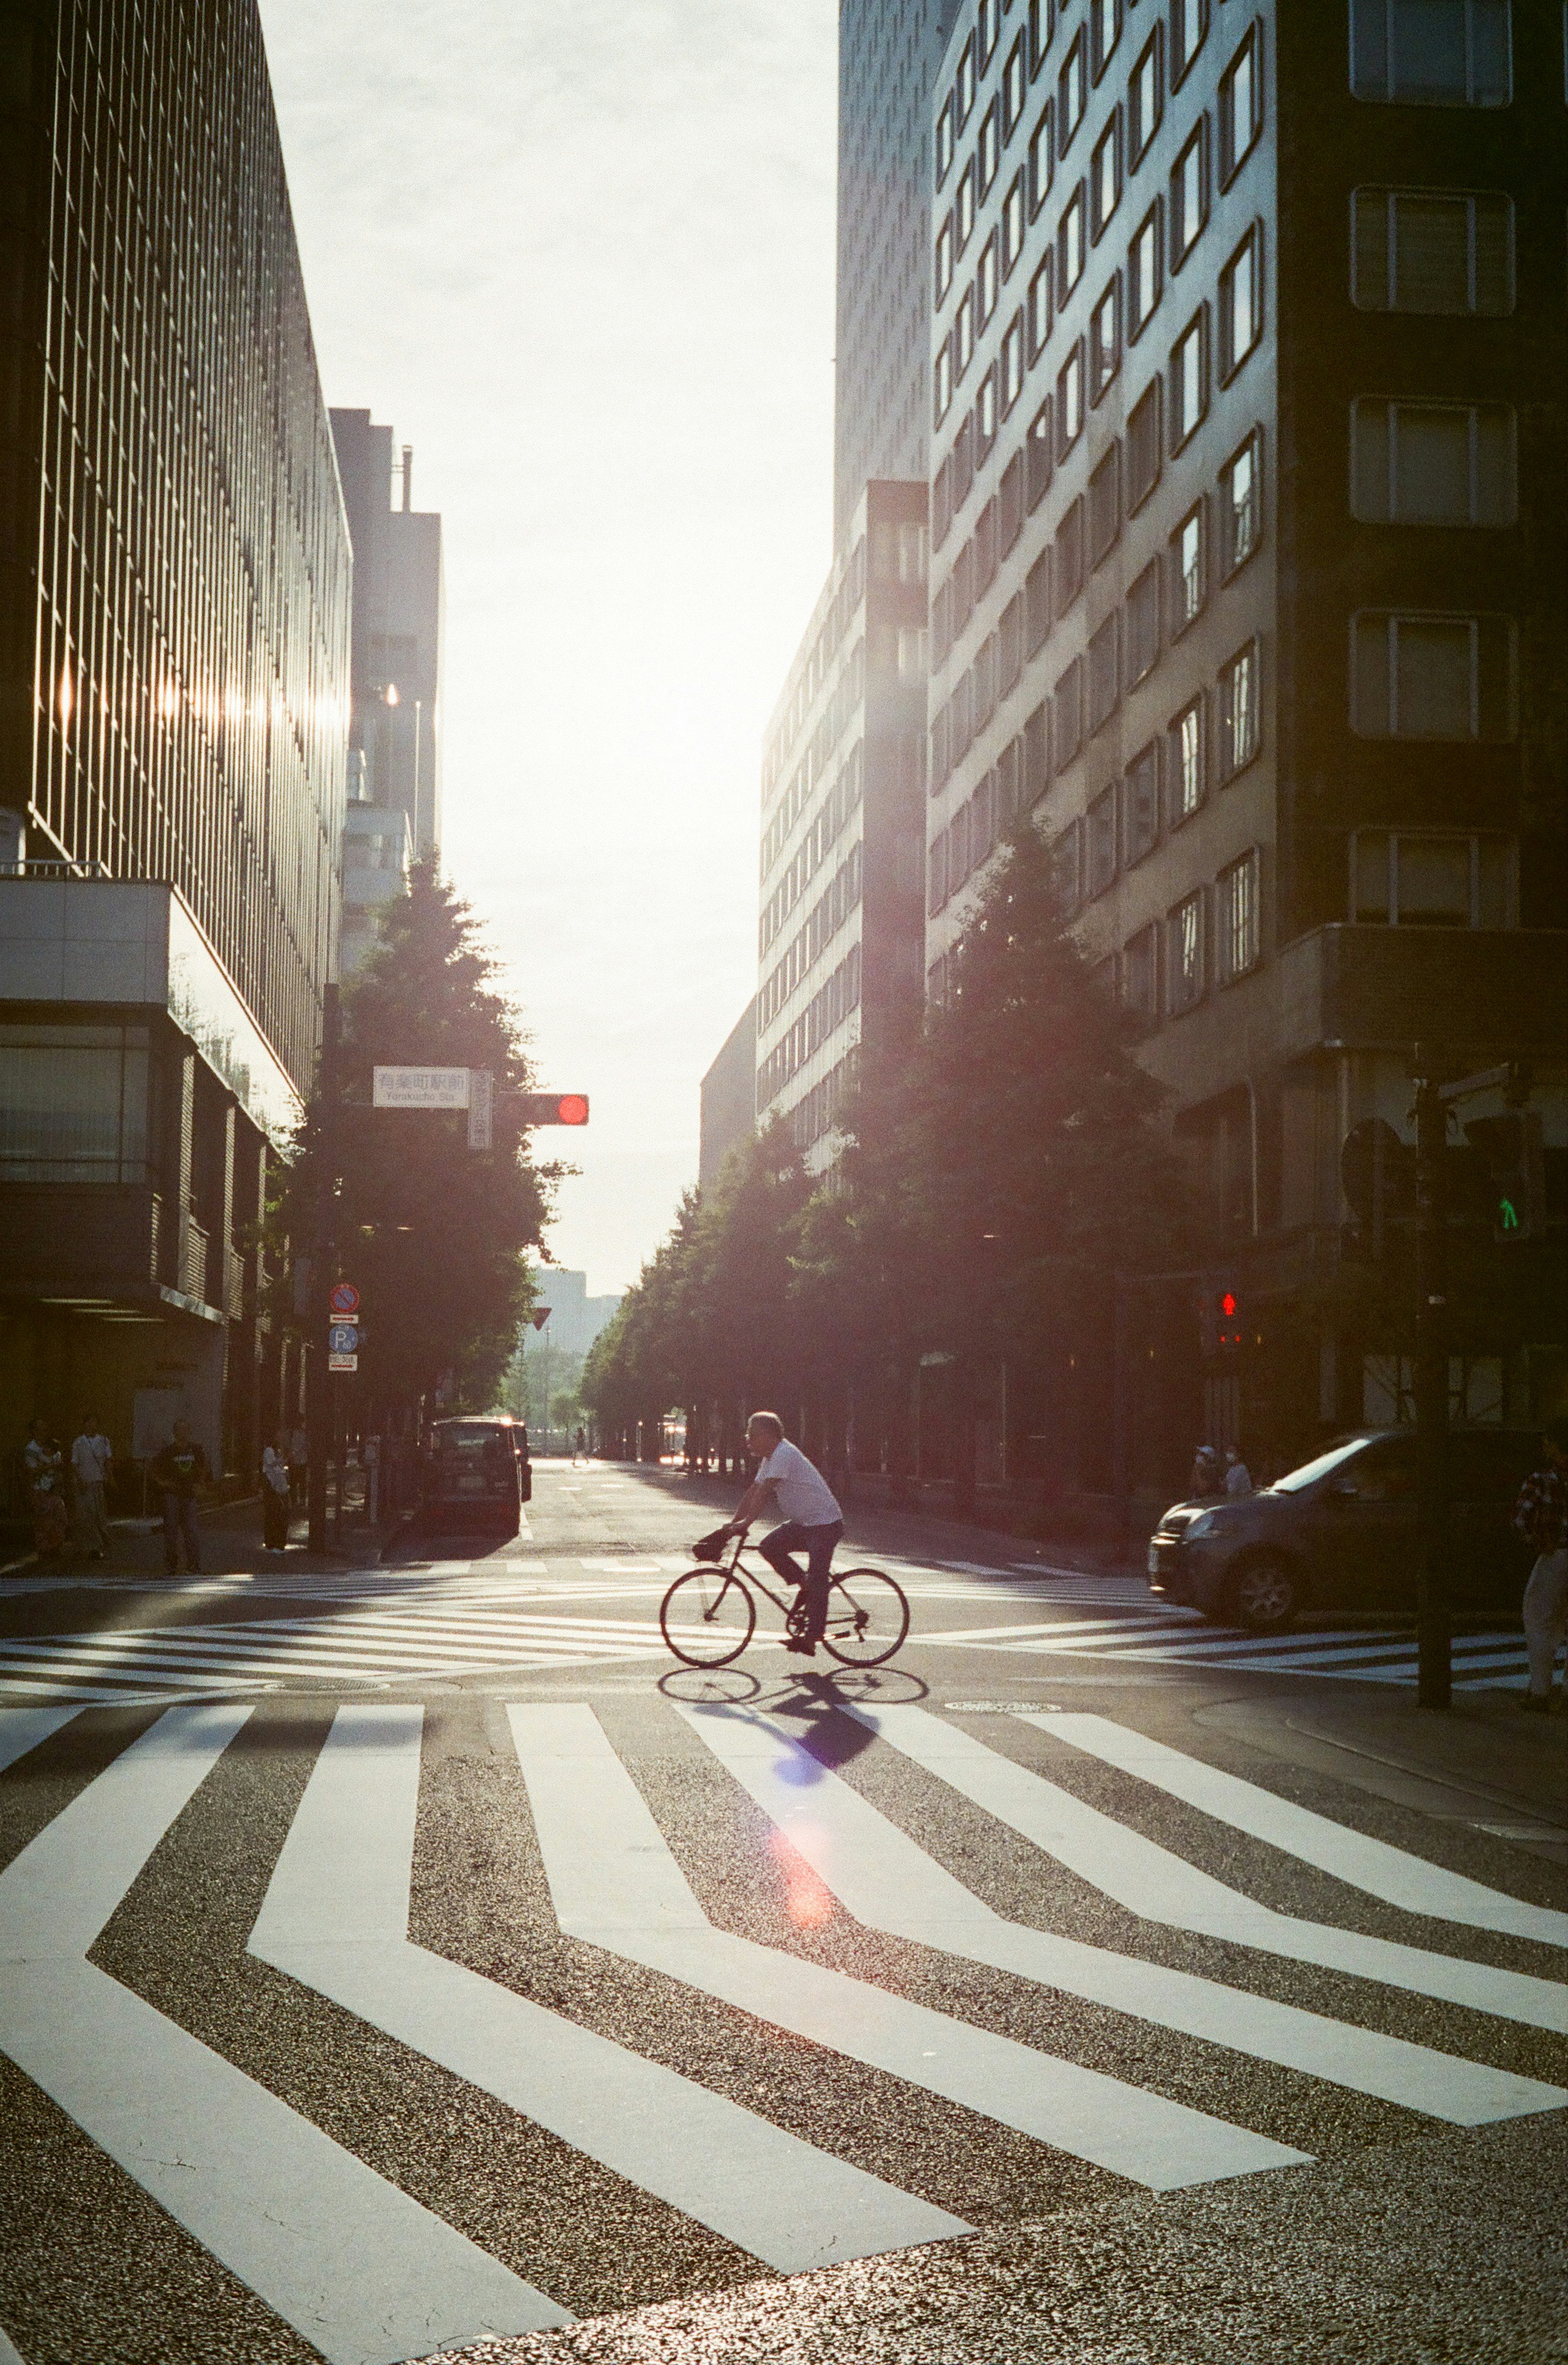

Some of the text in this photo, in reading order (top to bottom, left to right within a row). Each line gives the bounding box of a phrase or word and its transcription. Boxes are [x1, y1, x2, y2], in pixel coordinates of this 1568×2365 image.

[378, 1073, 464, 1090] 有楽町駅前
[335, 1331, 347, 1349] P
